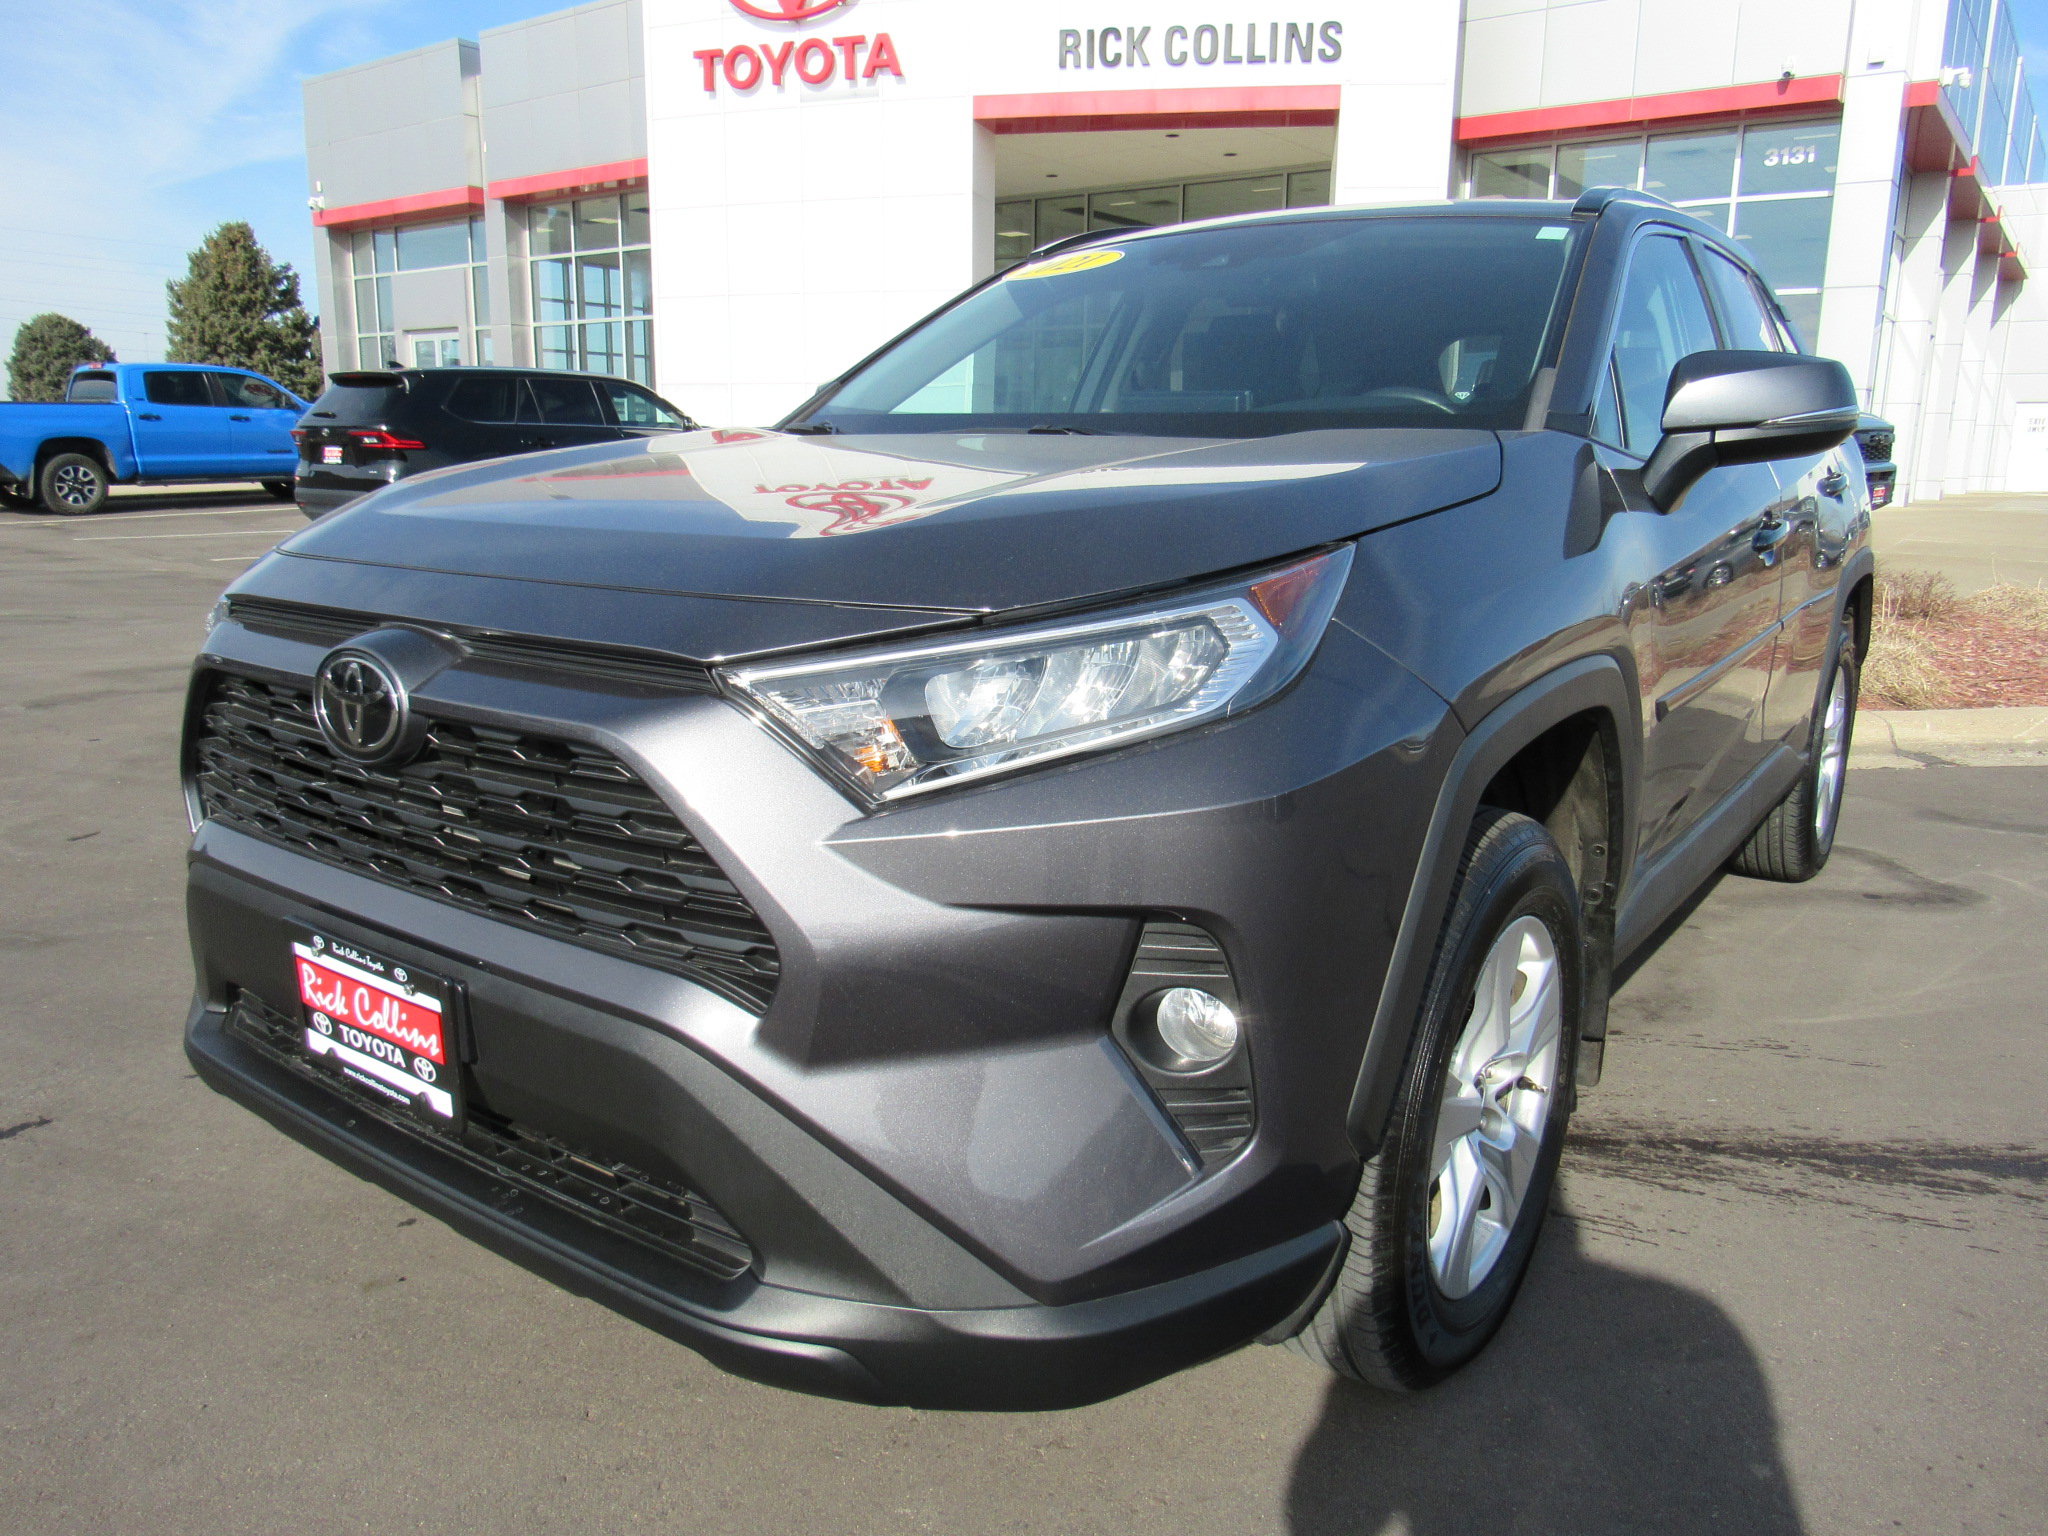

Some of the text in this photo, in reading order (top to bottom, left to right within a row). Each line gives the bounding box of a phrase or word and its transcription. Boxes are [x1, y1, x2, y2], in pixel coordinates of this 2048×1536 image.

[693, 32, 904, 92] TOYOTA
[1058, 20, 1343, 69] RICK COLLINS
[1763, 145, 1815, 167] 3131
[301, 963, 441, 1057] Rick Collins
[339, 1023, 407, 1068] TOYOTA
